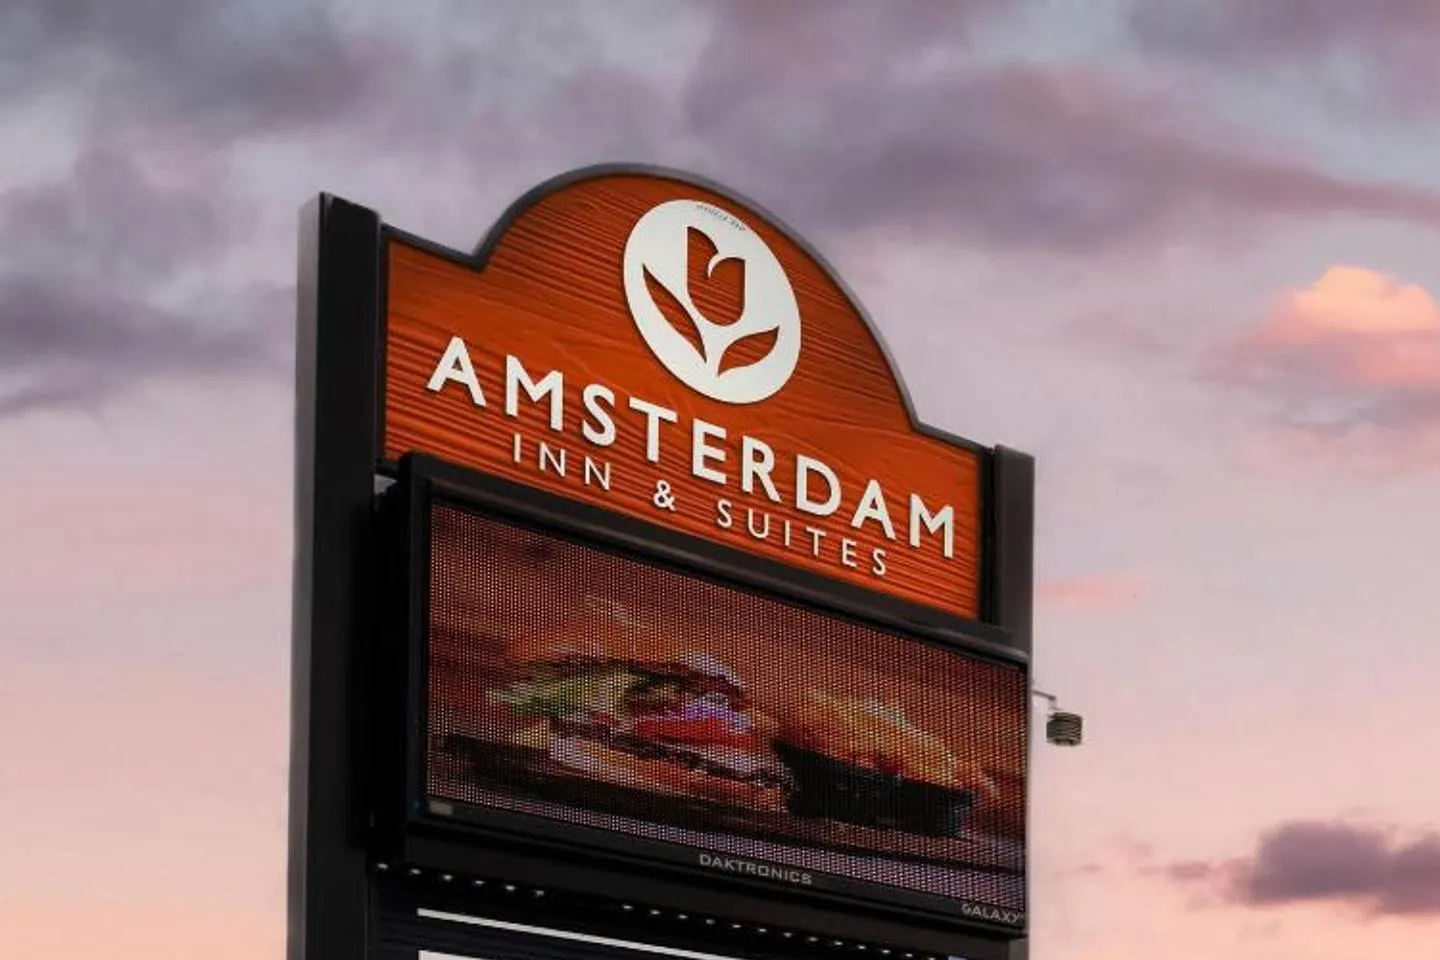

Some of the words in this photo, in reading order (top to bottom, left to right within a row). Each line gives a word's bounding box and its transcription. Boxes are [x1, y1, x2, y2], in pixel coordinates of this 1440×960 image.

[426, 336, 956, 559] AMSTERDAM
[512, 433, 612, 492] INN
[652, 479, 676, 512] &
[716, 499, 887, 577] SUITES
[699, 853, 813, 885] DAKTRONICS
[961, 902, 1020, 924] GALAXY
